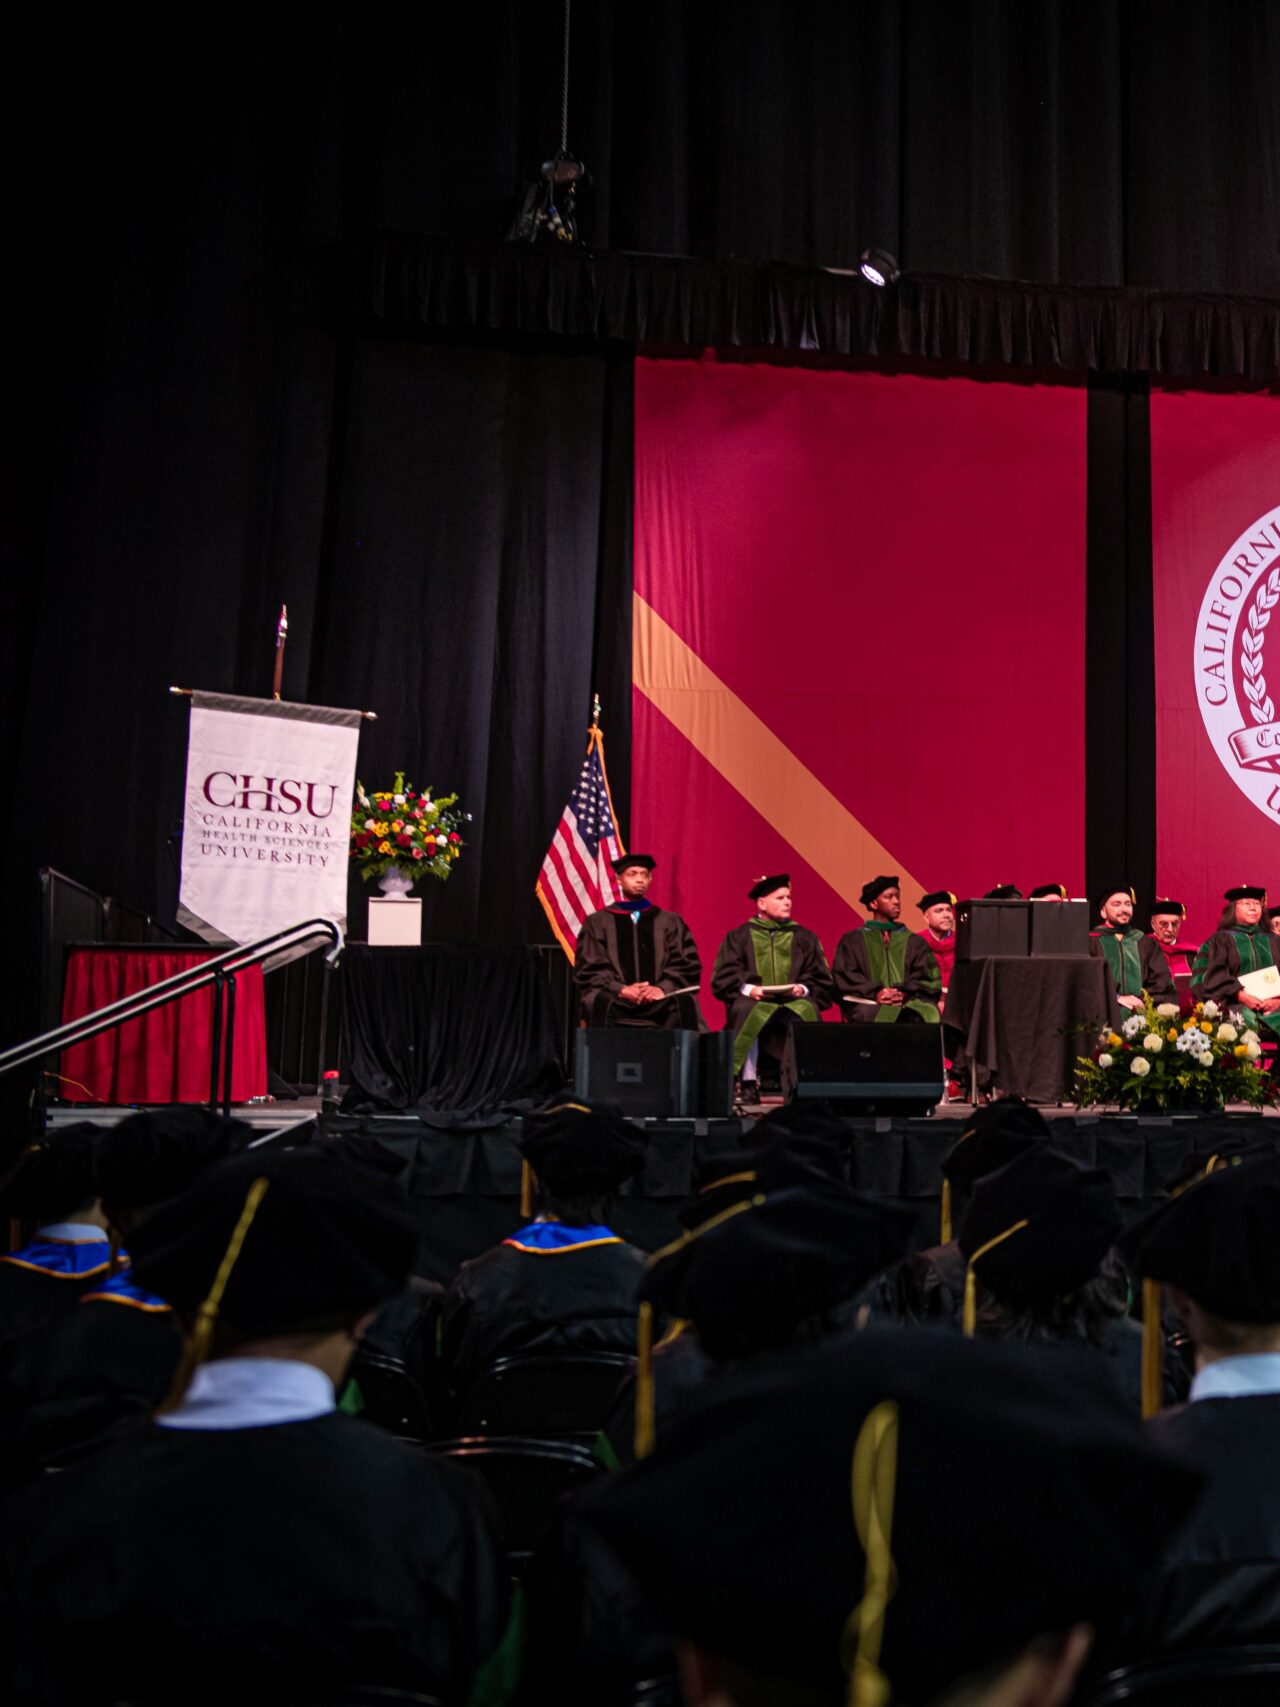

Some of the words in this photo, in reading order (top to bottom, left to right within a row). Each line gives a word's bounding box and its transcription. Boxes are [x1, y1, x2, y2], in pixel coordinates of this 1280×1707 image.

[203, 771, 339, 819] CHSU
[203, 814, 332, 838] CALIFORNIA
[202, 829, 257, 843] HEALTH
[264, 834, 330, 850] SCIENCES
[201, 843, 330, 868] UNIVERSITY
